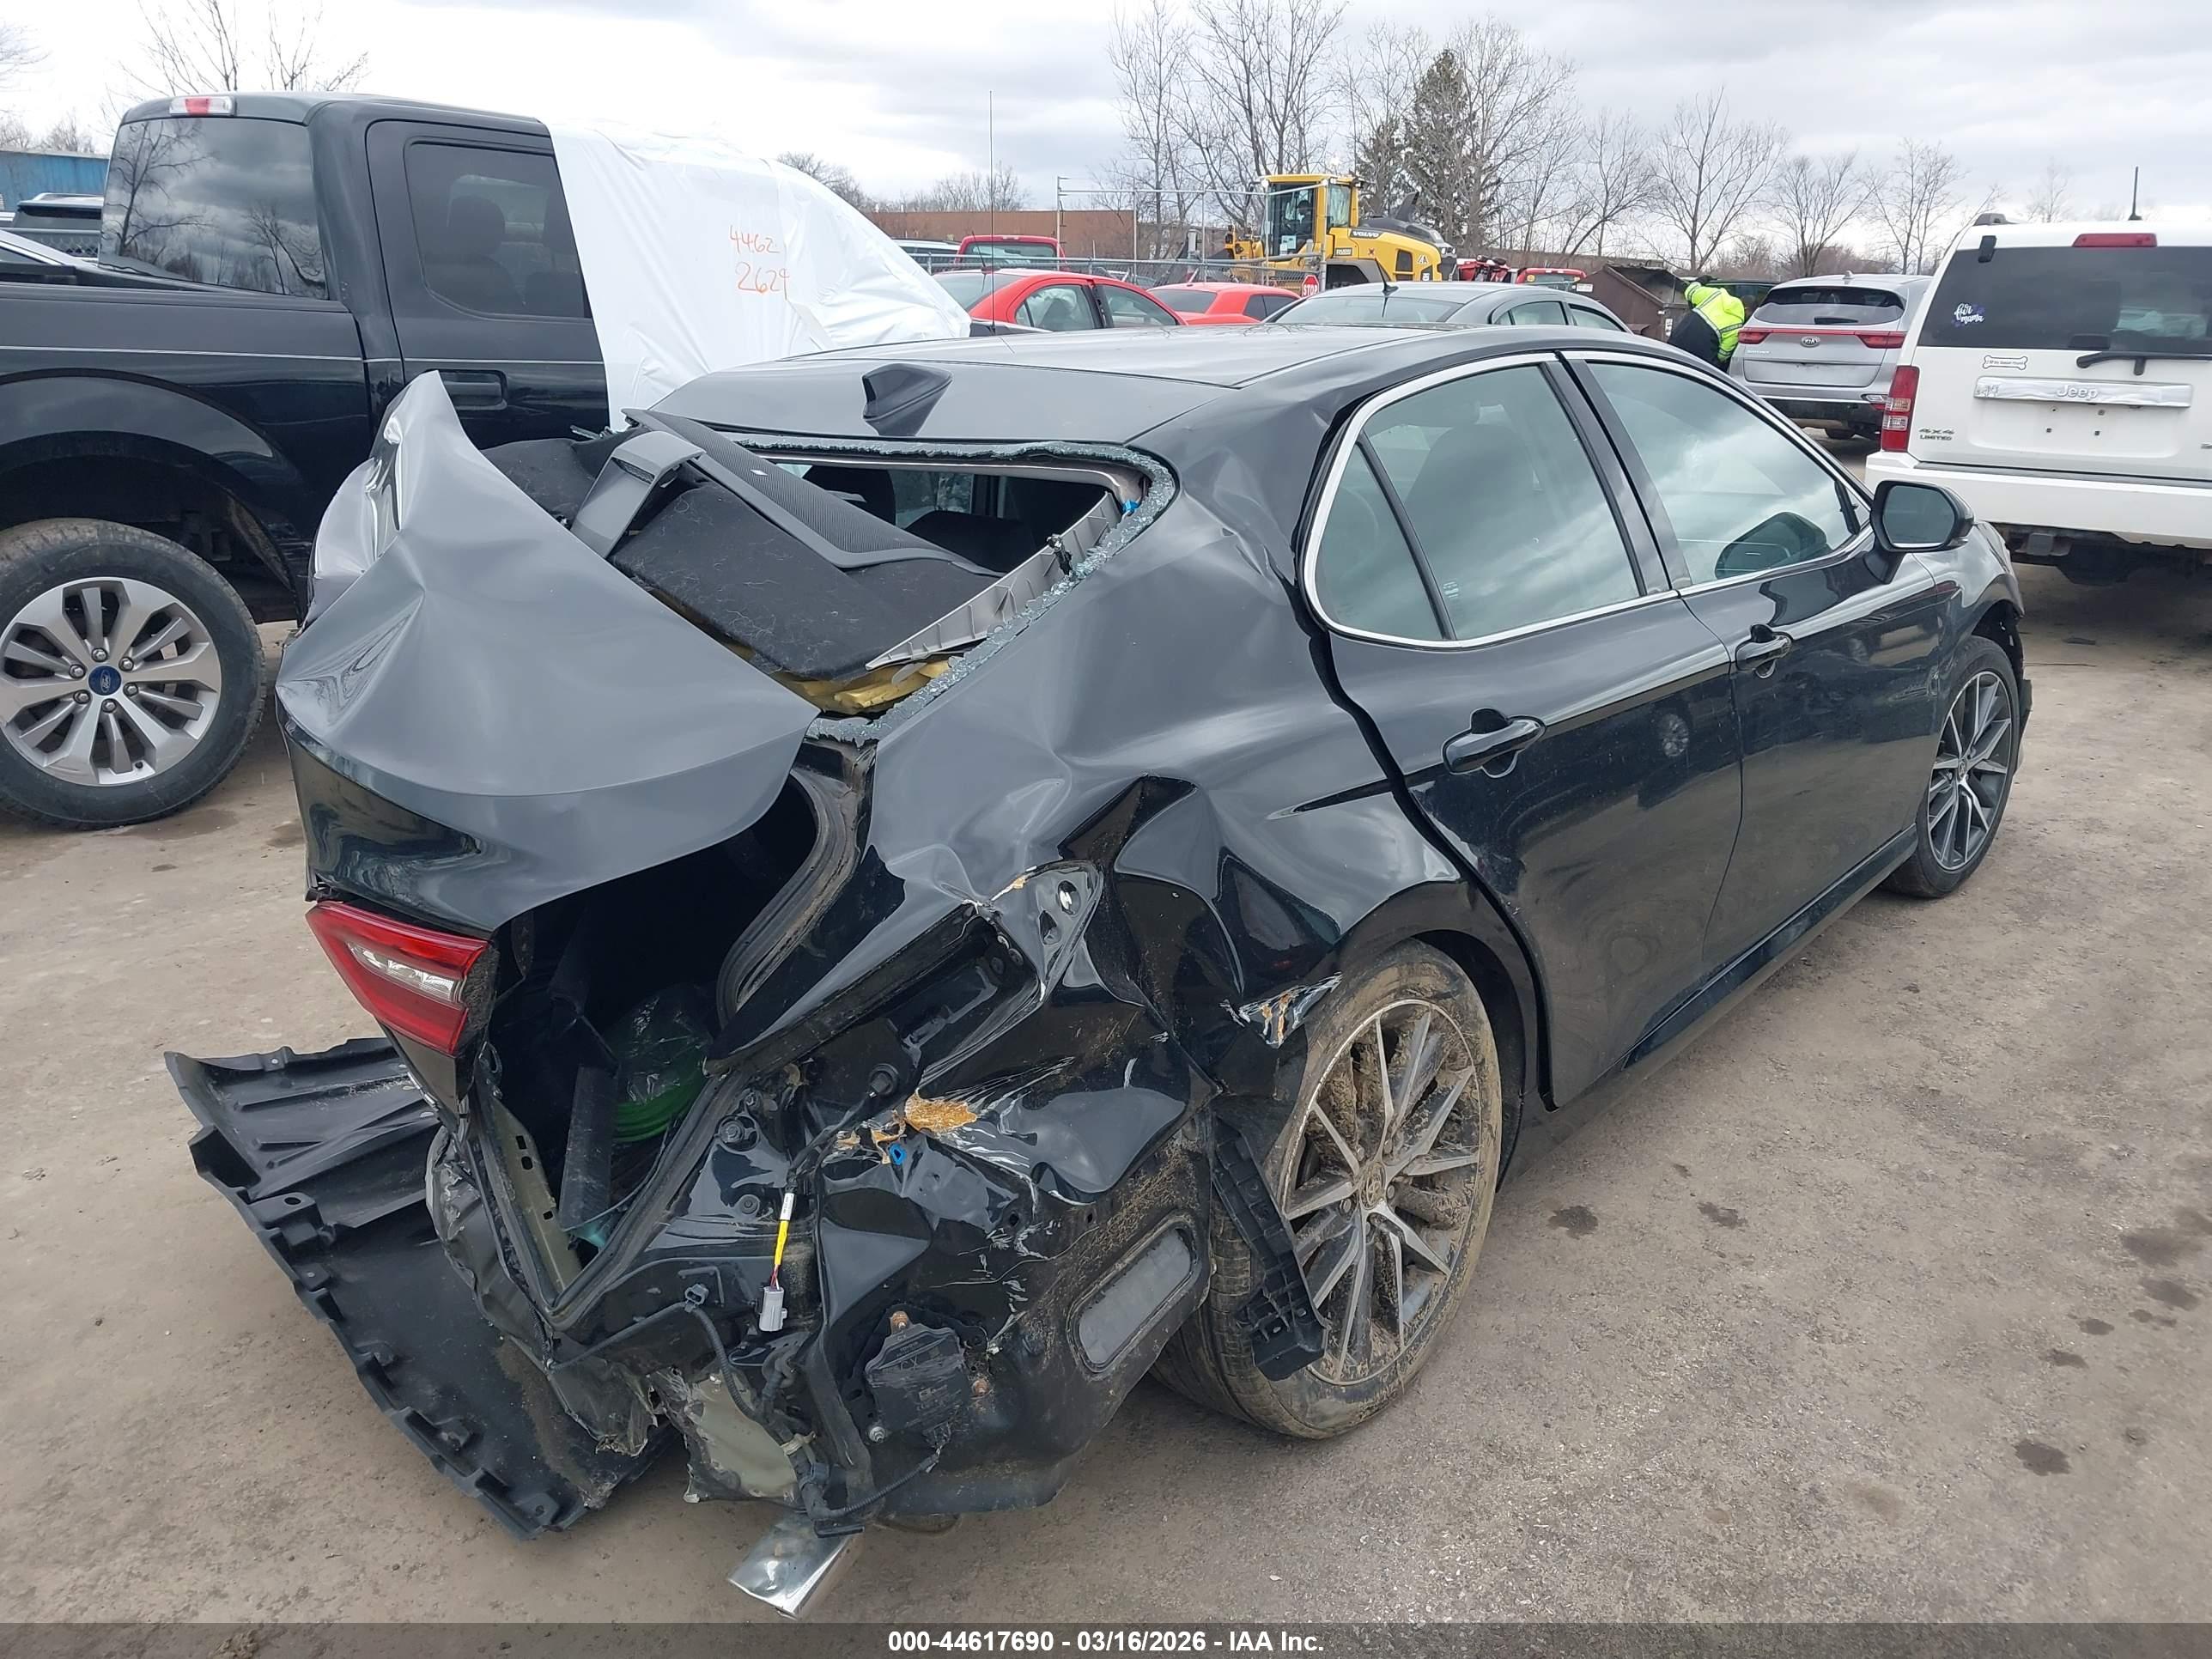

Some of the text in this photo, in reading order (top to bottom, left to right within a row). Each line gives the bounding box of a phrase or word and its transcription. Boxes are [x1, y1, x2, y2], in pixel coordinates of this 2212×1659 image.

[730, 225, 781, 254] 4462
[735, 261, 789, 300] 2629
[1304, 283, 1318, 296] STOP
[2057, 385, 2098, 401] Jeep
